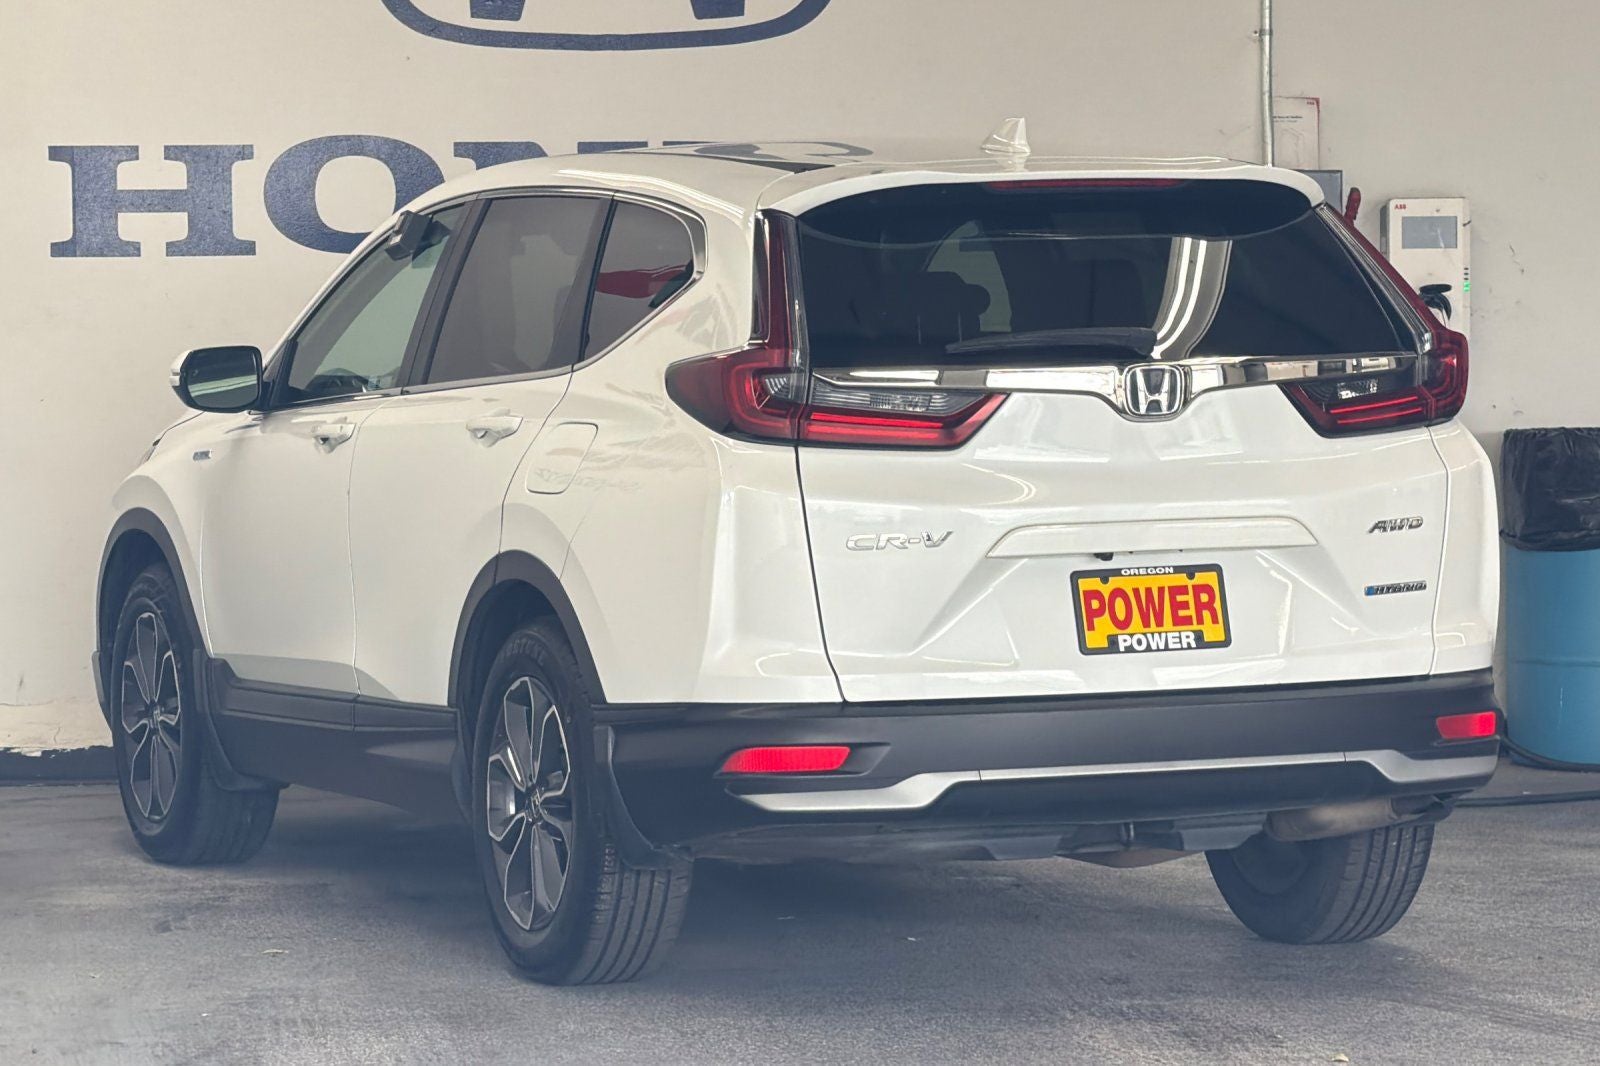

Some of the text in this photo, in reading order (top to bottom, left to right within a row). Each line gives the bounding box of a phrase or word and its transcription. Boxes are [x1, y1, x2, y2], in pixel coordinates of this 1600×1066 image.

[1367, 516, 1423, 533] AWD
[846, 530, 954, 551] CR-V
[1121, 566, 1174, 575] OREGON
[1082, 584, 1219, 631] POWER
[1118, 632, 1196, 651] POWER
